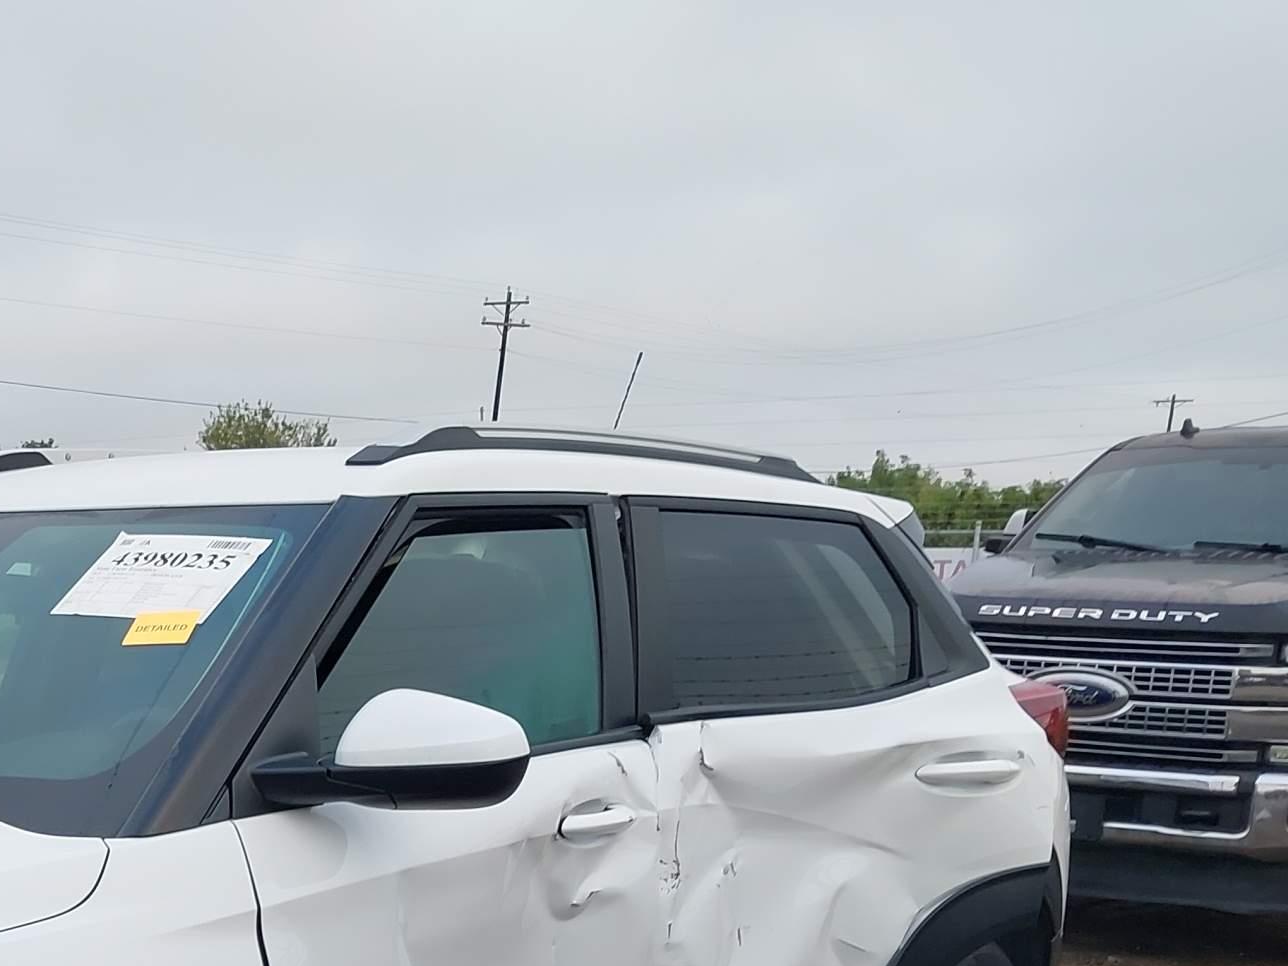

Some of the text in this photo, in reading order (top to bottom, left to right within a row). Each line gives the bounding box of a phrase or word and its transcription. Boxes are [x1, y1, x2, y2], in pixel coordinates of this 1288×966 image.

[112, 551, 237, 570] 43980235
[978, 604, 1220, 623] SUPER DUTY
[134, 623, 188, 633] DETAILED
